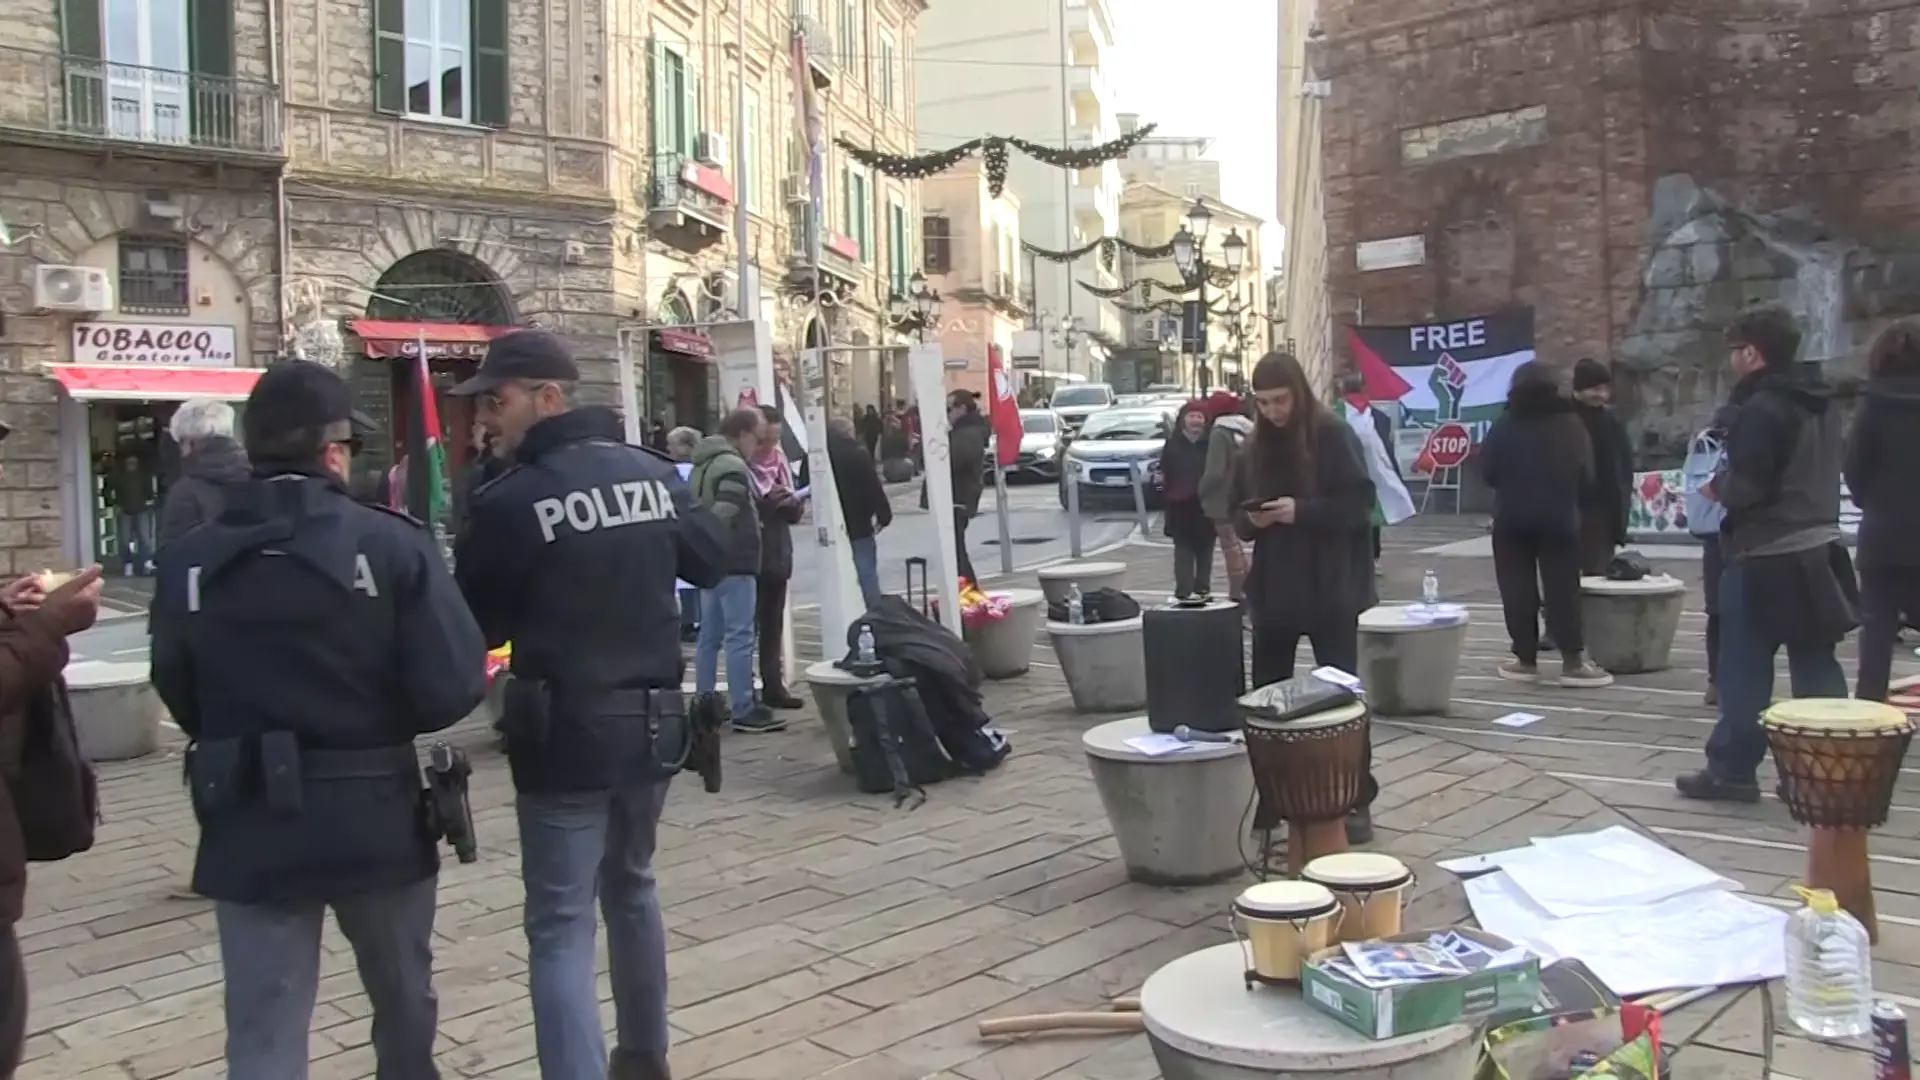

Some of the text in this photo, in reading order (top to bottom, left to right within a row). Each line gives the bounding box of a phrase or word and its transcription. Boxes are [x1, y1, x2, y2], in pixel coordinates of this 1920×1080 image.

[76, 326, 211, 351] TOBACCO
[1410, 320, 1486, 352] FREE
[1432, 436, 1468, 453] STOP
[533, 480, 677, 543] POLIZIA
